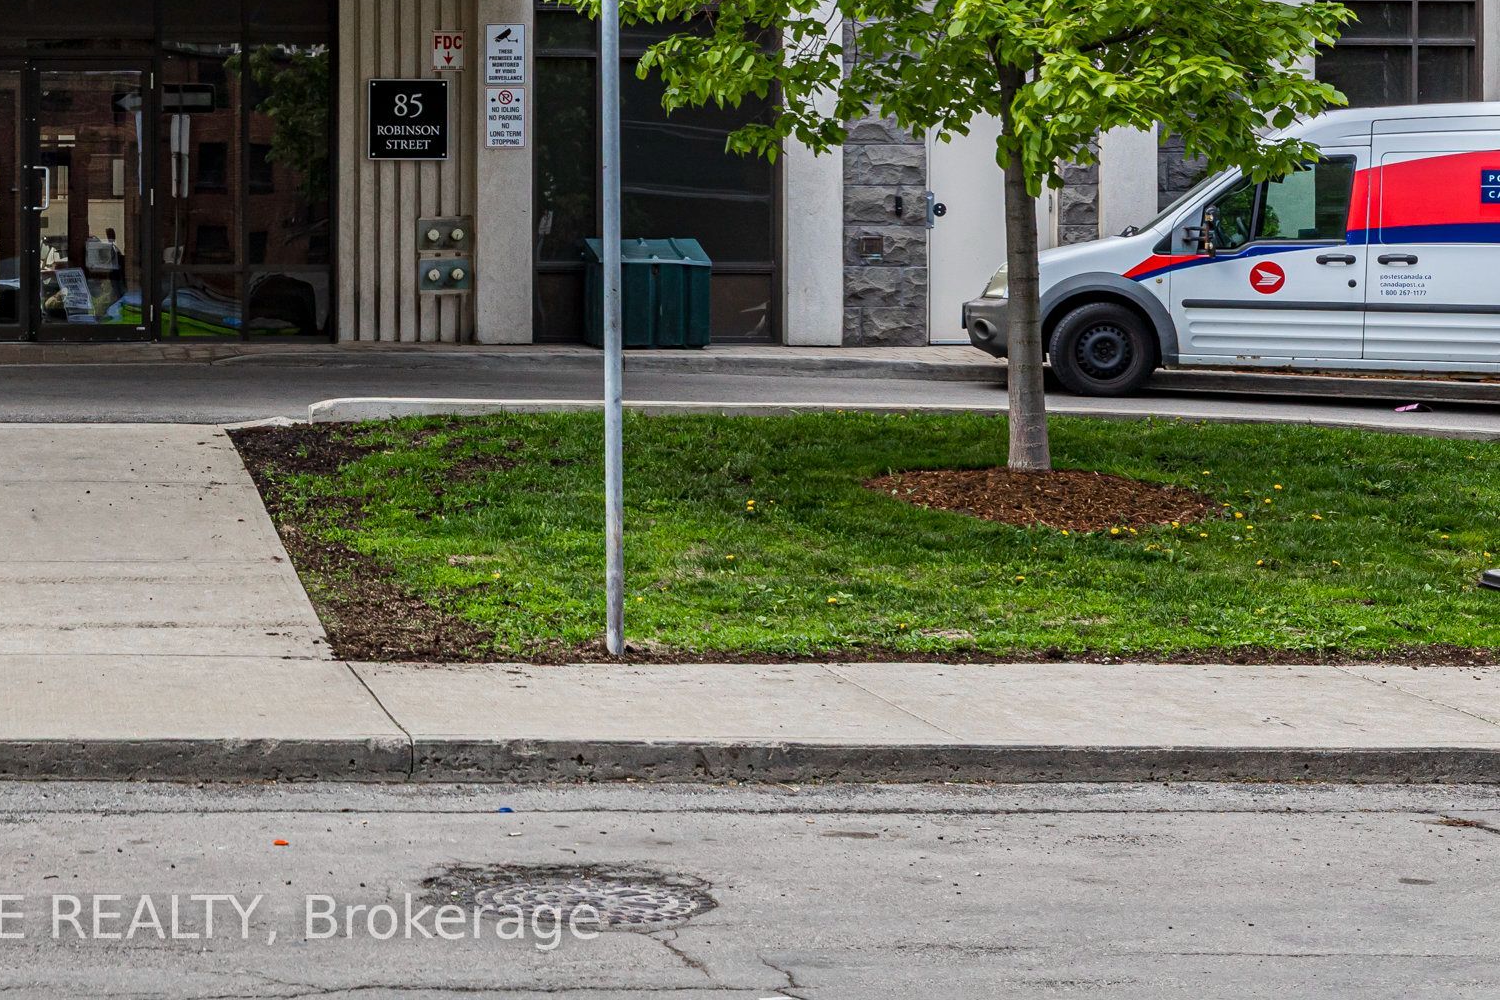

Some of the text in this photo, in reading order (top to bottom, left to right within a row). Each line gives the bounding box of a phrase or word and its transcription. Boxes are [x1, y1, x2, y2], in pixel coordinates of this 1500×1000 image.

[434, 35, 463, 50] FDC
[394, 93, 423, 118] 85
[377, 125, 440, 136] ROBINSON
[385, 139, 432, 150] STREET
